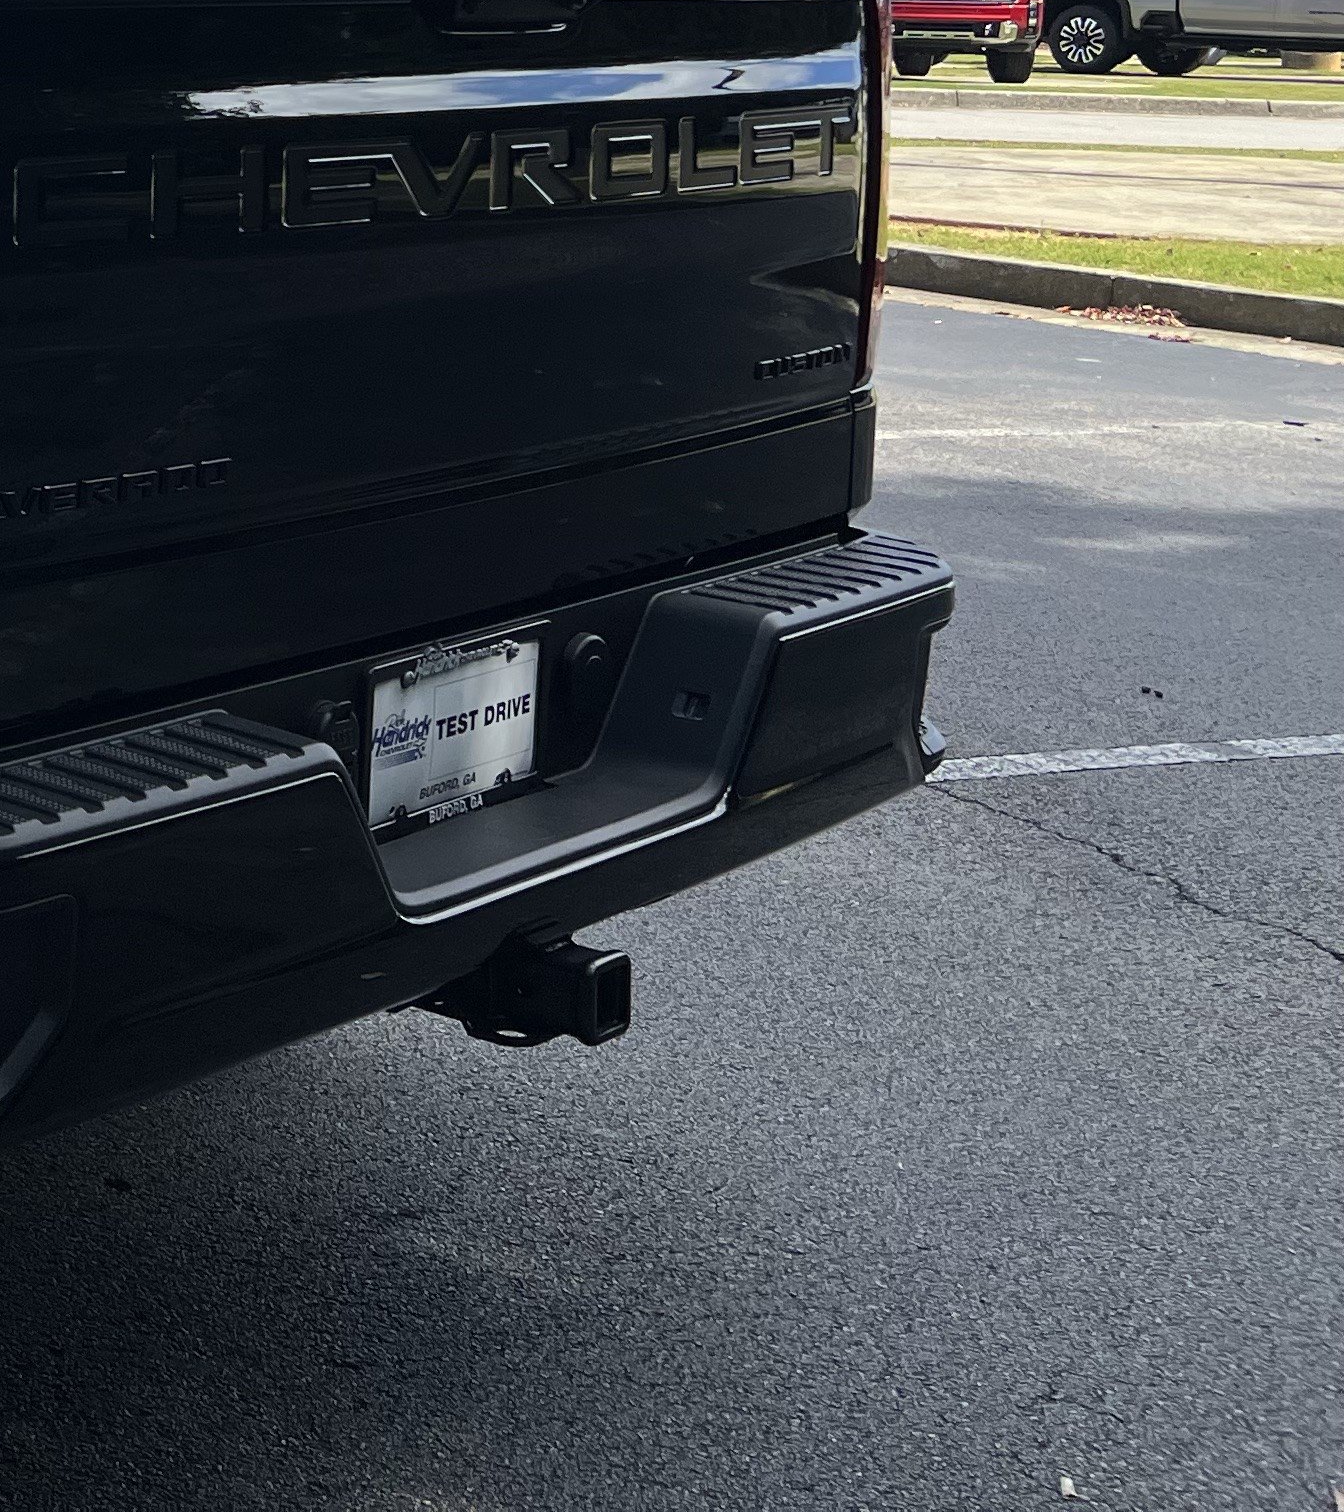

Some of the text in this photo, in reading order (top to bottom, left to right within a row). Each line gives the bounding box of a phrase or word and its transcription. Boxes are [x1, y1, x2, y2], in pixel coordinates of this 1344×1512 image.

[11, 102, 854, 247] CHEVROLET
[754, 342, 852, 380] CUSTOM
[373, 715, 432, 757] Hendrick
[436, 693, 531, 740] TEST DRIVE
[462, 772, 476, 787] GA
[470, 794, 484, 809] GA
